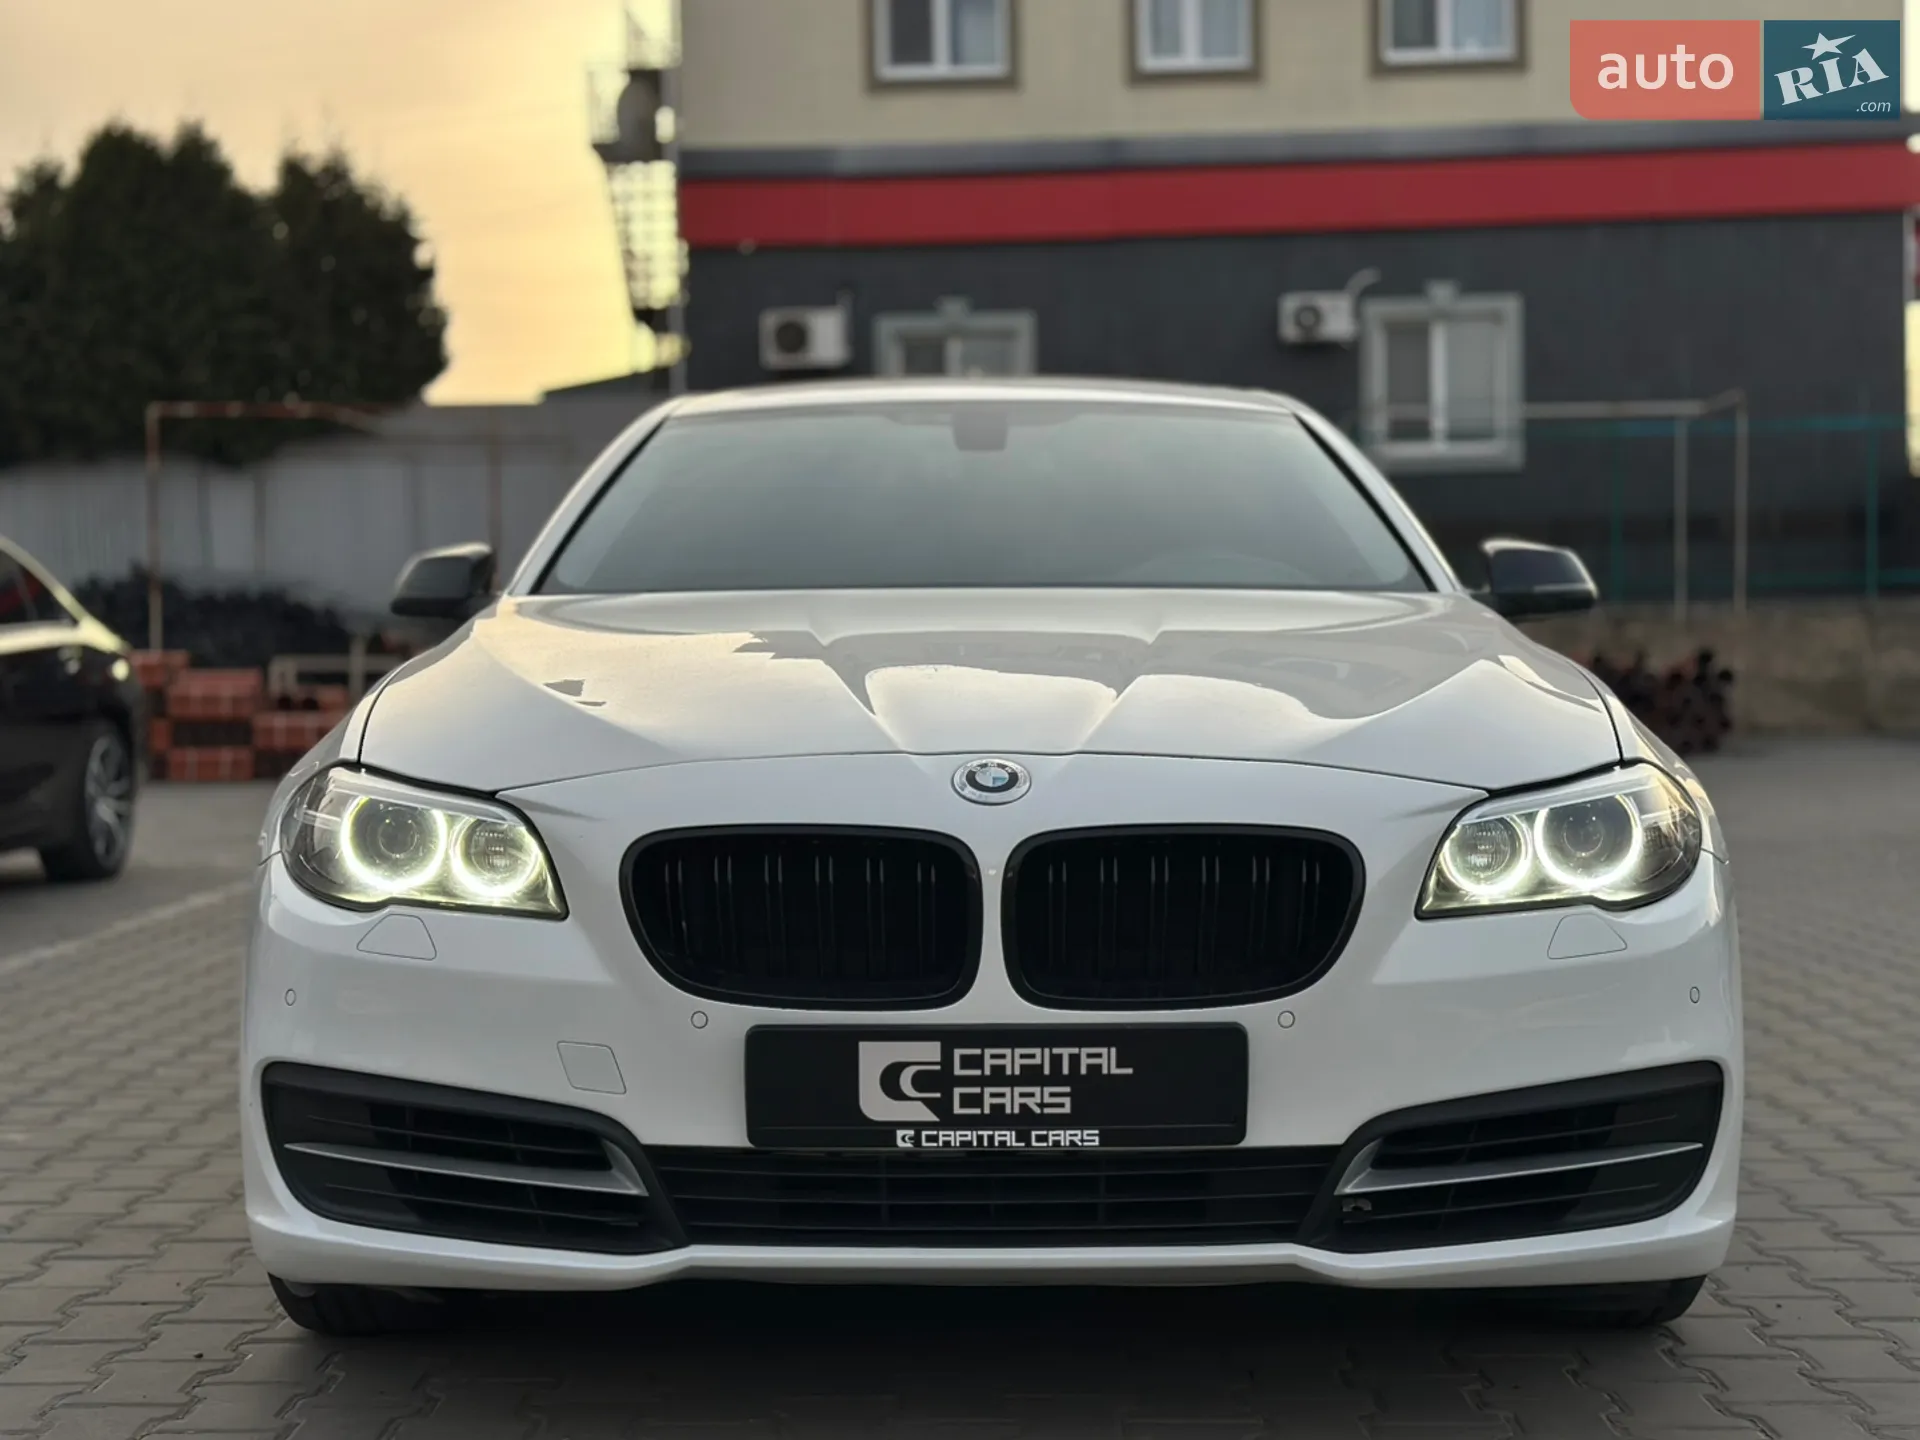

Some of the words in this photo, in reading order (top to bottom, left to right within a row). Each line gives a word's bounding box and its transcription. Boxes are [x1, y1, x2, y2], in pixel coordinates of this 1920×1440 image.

[953, 1047, 1133, 1075] CAPITAL
[953, 1086, 1071, 1114] CARS
[921, 1130, 1025, 1147] CAPITAL
[1031, 1130, 1100, 1147] CARS
